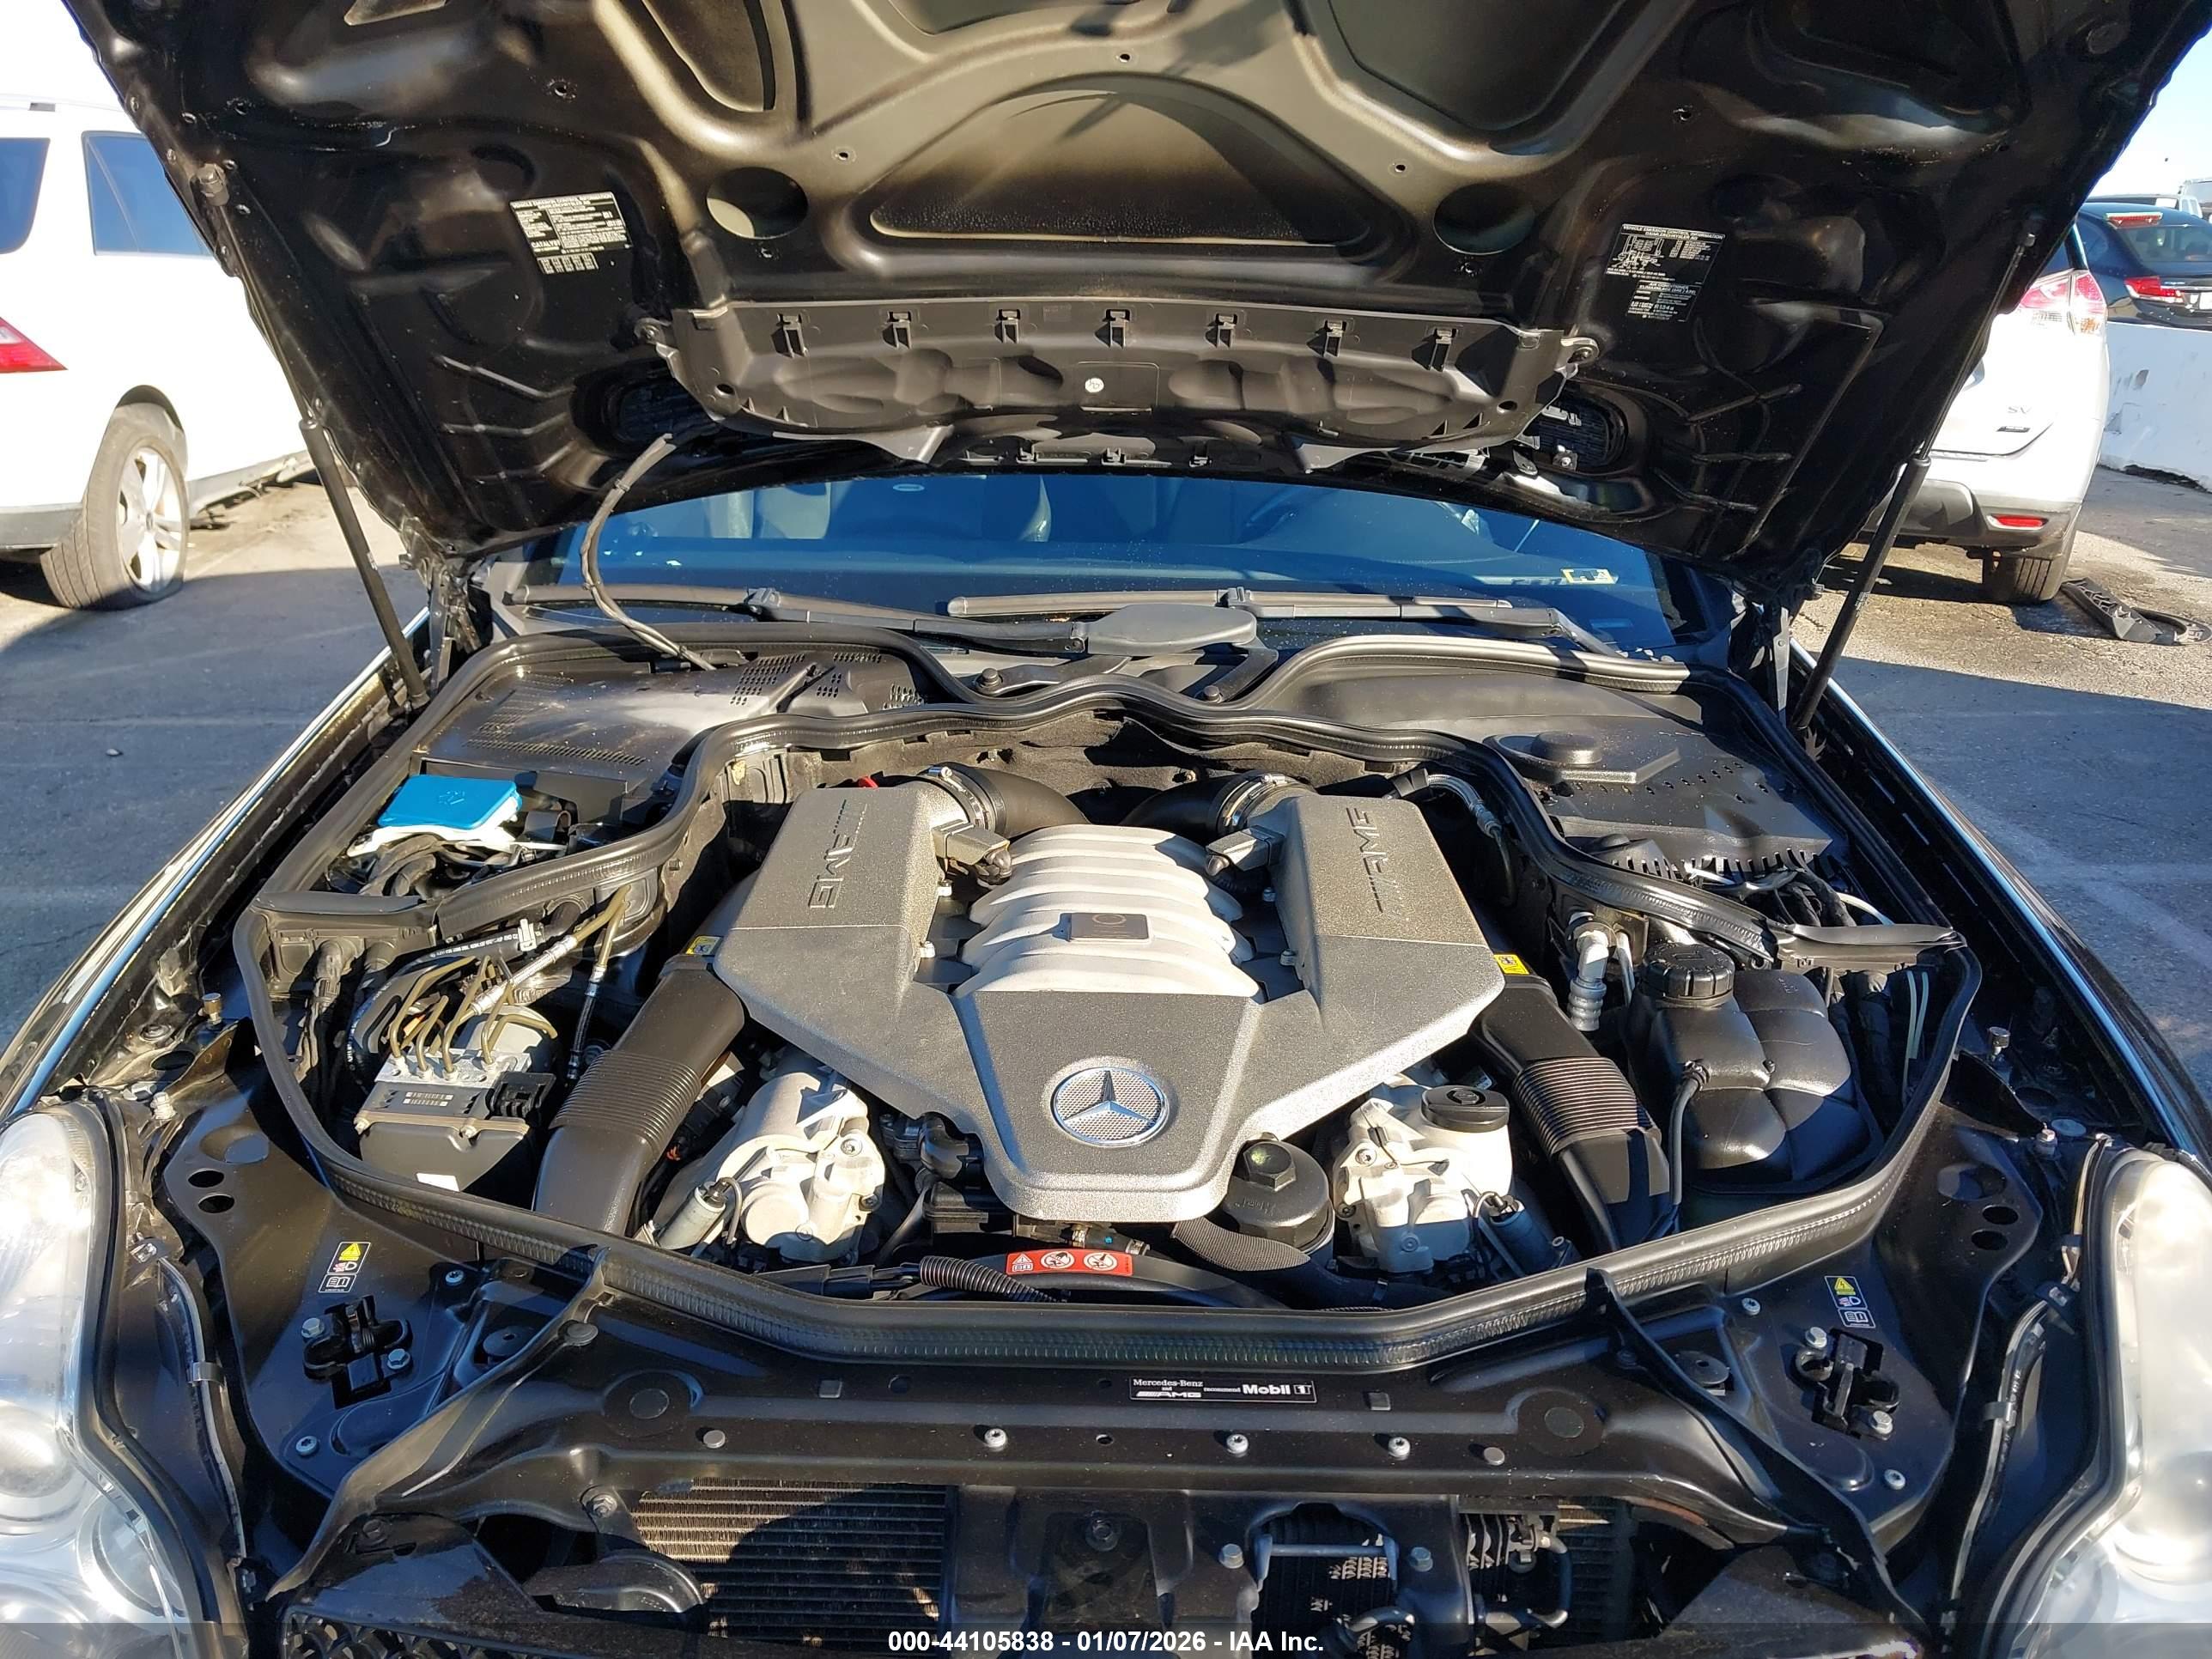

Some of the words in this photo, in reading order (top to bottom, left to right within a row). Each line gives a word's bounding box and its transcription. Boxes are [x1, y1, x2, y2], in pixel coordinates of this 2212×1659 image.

[531, 240, 561, 248] CATALYST
[2008, 406, 2033, 415] SV
[1133, 1379, 1204, 1388] Mercedes-Benz
[1243, 1383, 1291, 1395] Mobil
